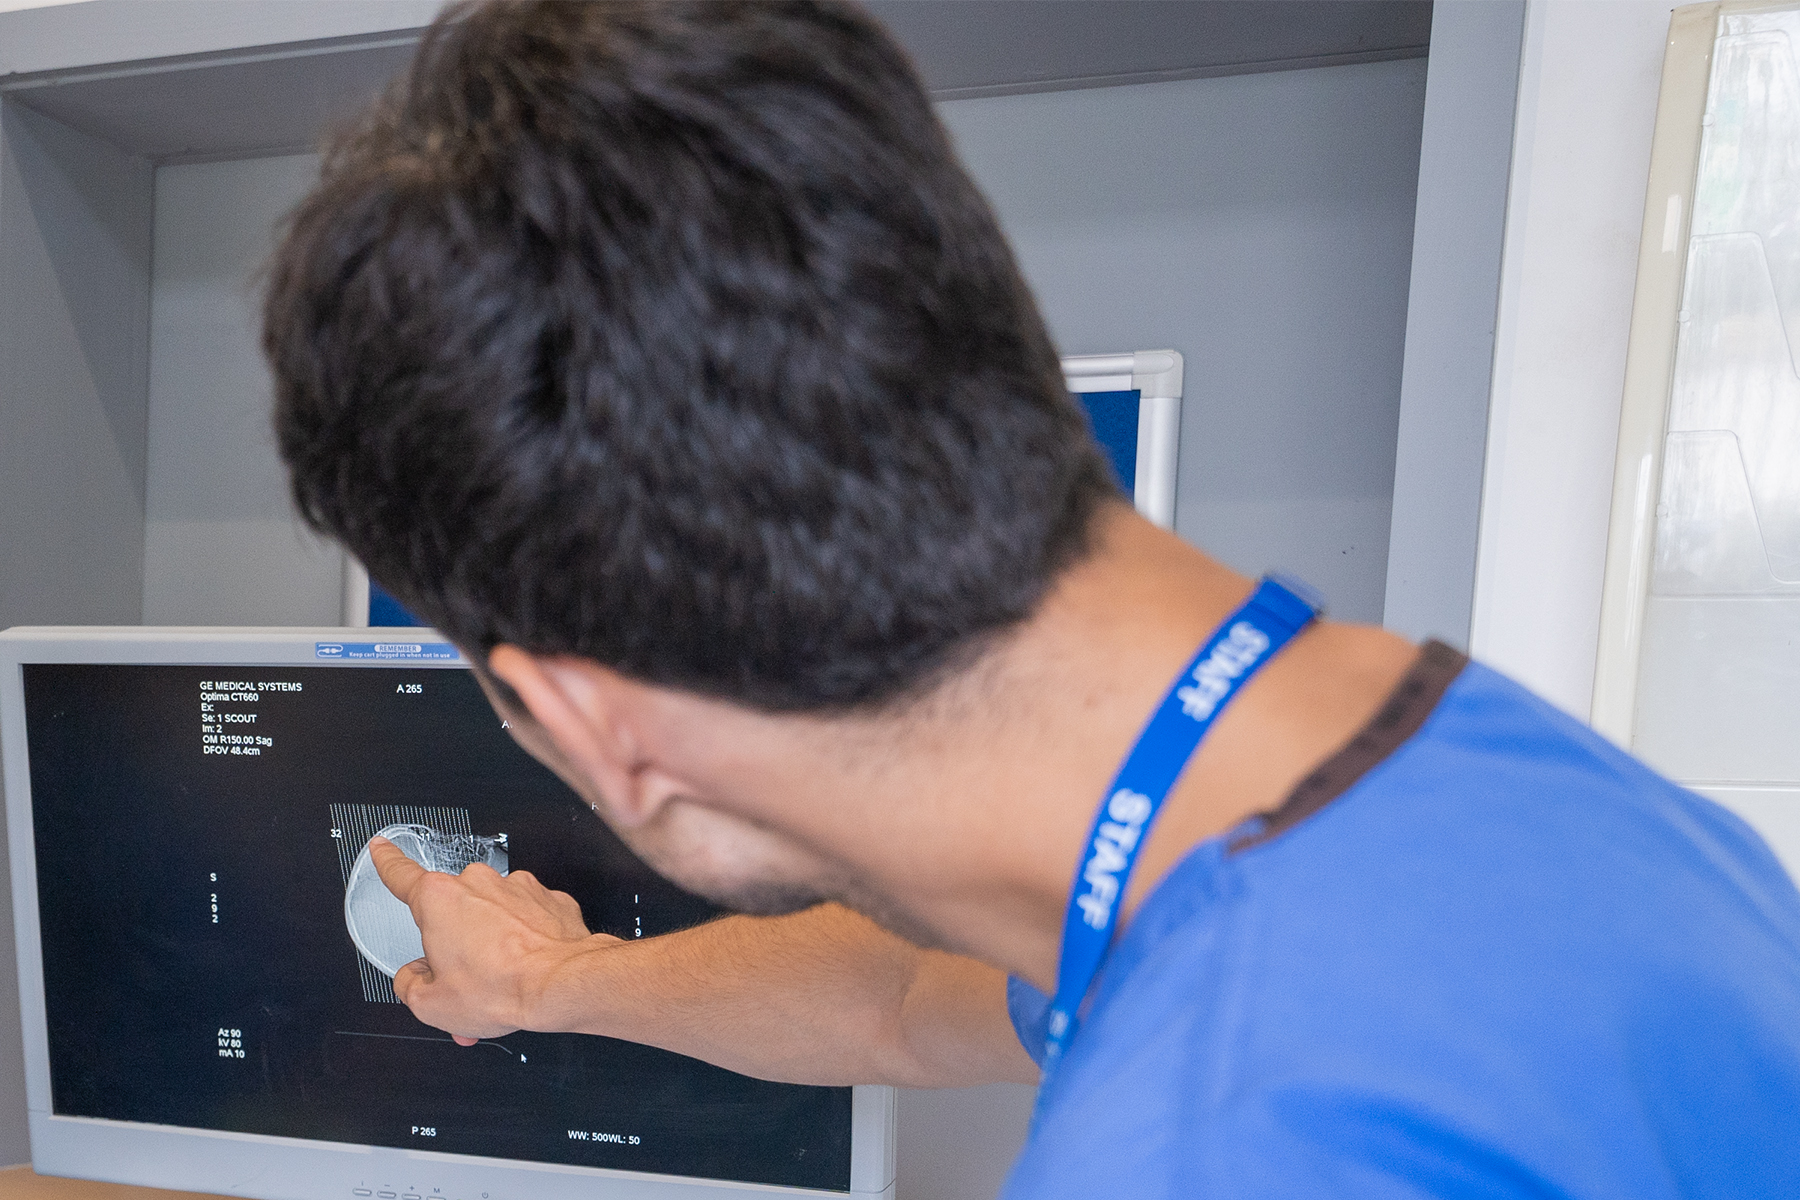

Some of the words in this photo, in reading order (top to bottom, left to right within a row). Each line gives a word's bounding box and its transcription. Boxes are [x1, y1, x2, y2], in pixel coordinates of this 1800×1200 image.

[199, 681, 213, 691] GE
[215, 681, 256, 691] MEDICAL
[257, 682, 303, 692] SYSTEMS
[396, 684, 405, 693] A
[405, 684, 422, 693] 265
[200, 692, 230, 702] Optima
[230, 692, 259, 702] CT660
[201, 703, 214, 712] Ex:
[202, 713, 216, 722] Se:
[217, 714, 222, 722] 1
[224, 714, 257, 723] SCOUT
[202, 724, 215, 733] Im:
[216, 724, 223, 733] 2
[202, 735, 218, 744] OM
[220, 735, 254, 744] R150.00
[255, 736, 273, 747] Sag
[203, 745, 229, 755] DFOV
[230, 746, 261, 756] 48.4cm
[210, 872, 217, 882] S
[218, 1028, 230, 1037] Az
[230, 1029, 242, 1038] 90
[218, 1038, 230, 1047] kV
[230, 1039, 242, 1048] 80
[219, 1048, 233, 1058] mA
[234, 1049, 245, 1059] 10
[411, 1126, 419, 1135] P
[420, 1127, 437, 1137] 265
[567, 1130, 590, 1141] WW:
[628, 1135, 640, 1145] 50
